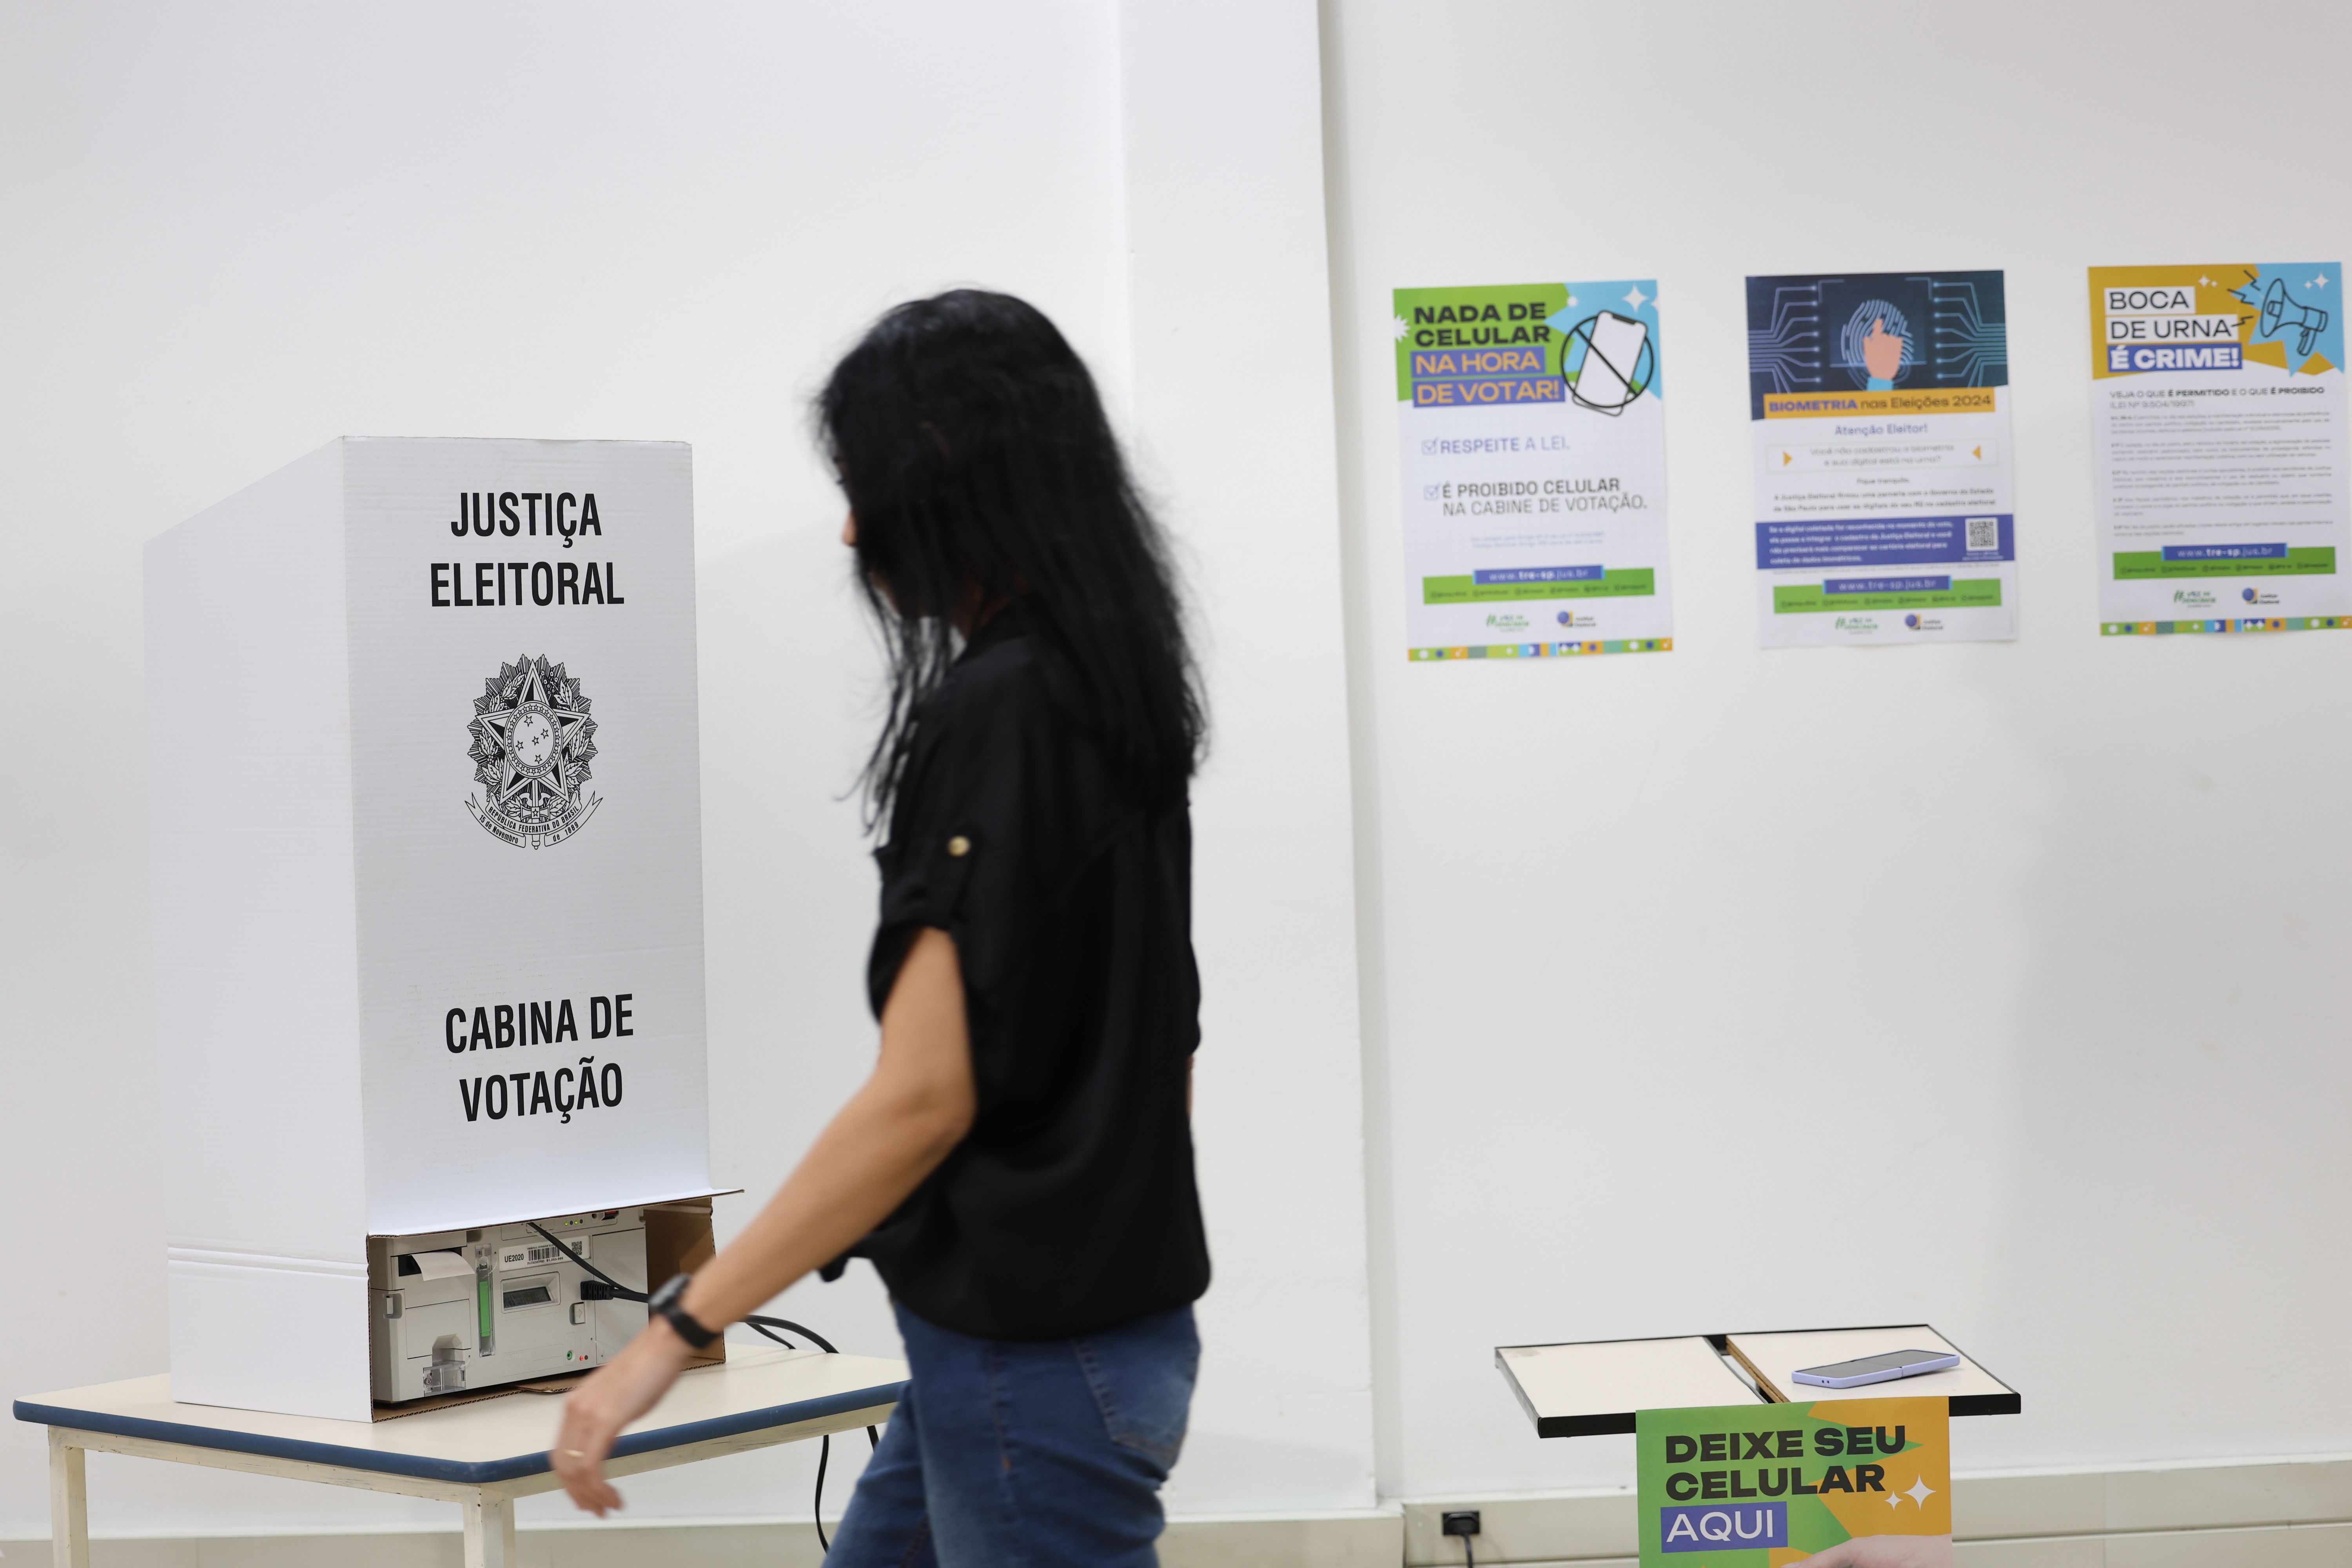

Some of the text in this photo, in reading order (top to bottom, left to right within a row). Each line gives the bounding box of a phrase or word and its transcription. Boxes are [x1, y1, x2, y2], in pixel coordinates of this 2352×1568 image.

[2109, 290, 2189, 310] BOCA
[1414, 302, 1546, 325] NADA DE
[1415, 325, 1550, 347] CELULAR
[2111, 319, 2232, 339] DE URNA
[1416, 351, 1541, 374] NA HORA
[2111, 345, 2239, 370] É CRIME!
[1418, 380, 1560, 404] DE VOTAR!
[1769, 395, 1991, 412] BIOMETRIA nas Eleições 2024
[1835, 423, 1928, 437] Atenção Eleitor!
[1441, 436, 1570, 454] RESPEITE A LEI.
[1443, 478, 1620, 498] É PROIBIDO CELULAR
[1443, 492, 1647, 516] NA CABINE DE VOTAÇÃO.
[451, 492, 602, 548] JUSTIÇA
[431, 561, 624, 607] ELEITORAL
[479, 815, 519, 844] 15 de Novembro
[488, 806, 580, 833] REPÚBLICA FEDERATIVA DO BRASIL
[552, 822, 579, 842] de 1889
[445, 993, 633, 1053] CABINA DE
[459, 1056, 622, 1124] VOTAÇÃO
[505, 1254, 524, 1263] UE2020
[1665, 1425, 1907, 1463] DEIXE SEU
[1665, 1464, 1886, 1501] CELULAR
[1666, 1510, 1773, 1542] AQUI
